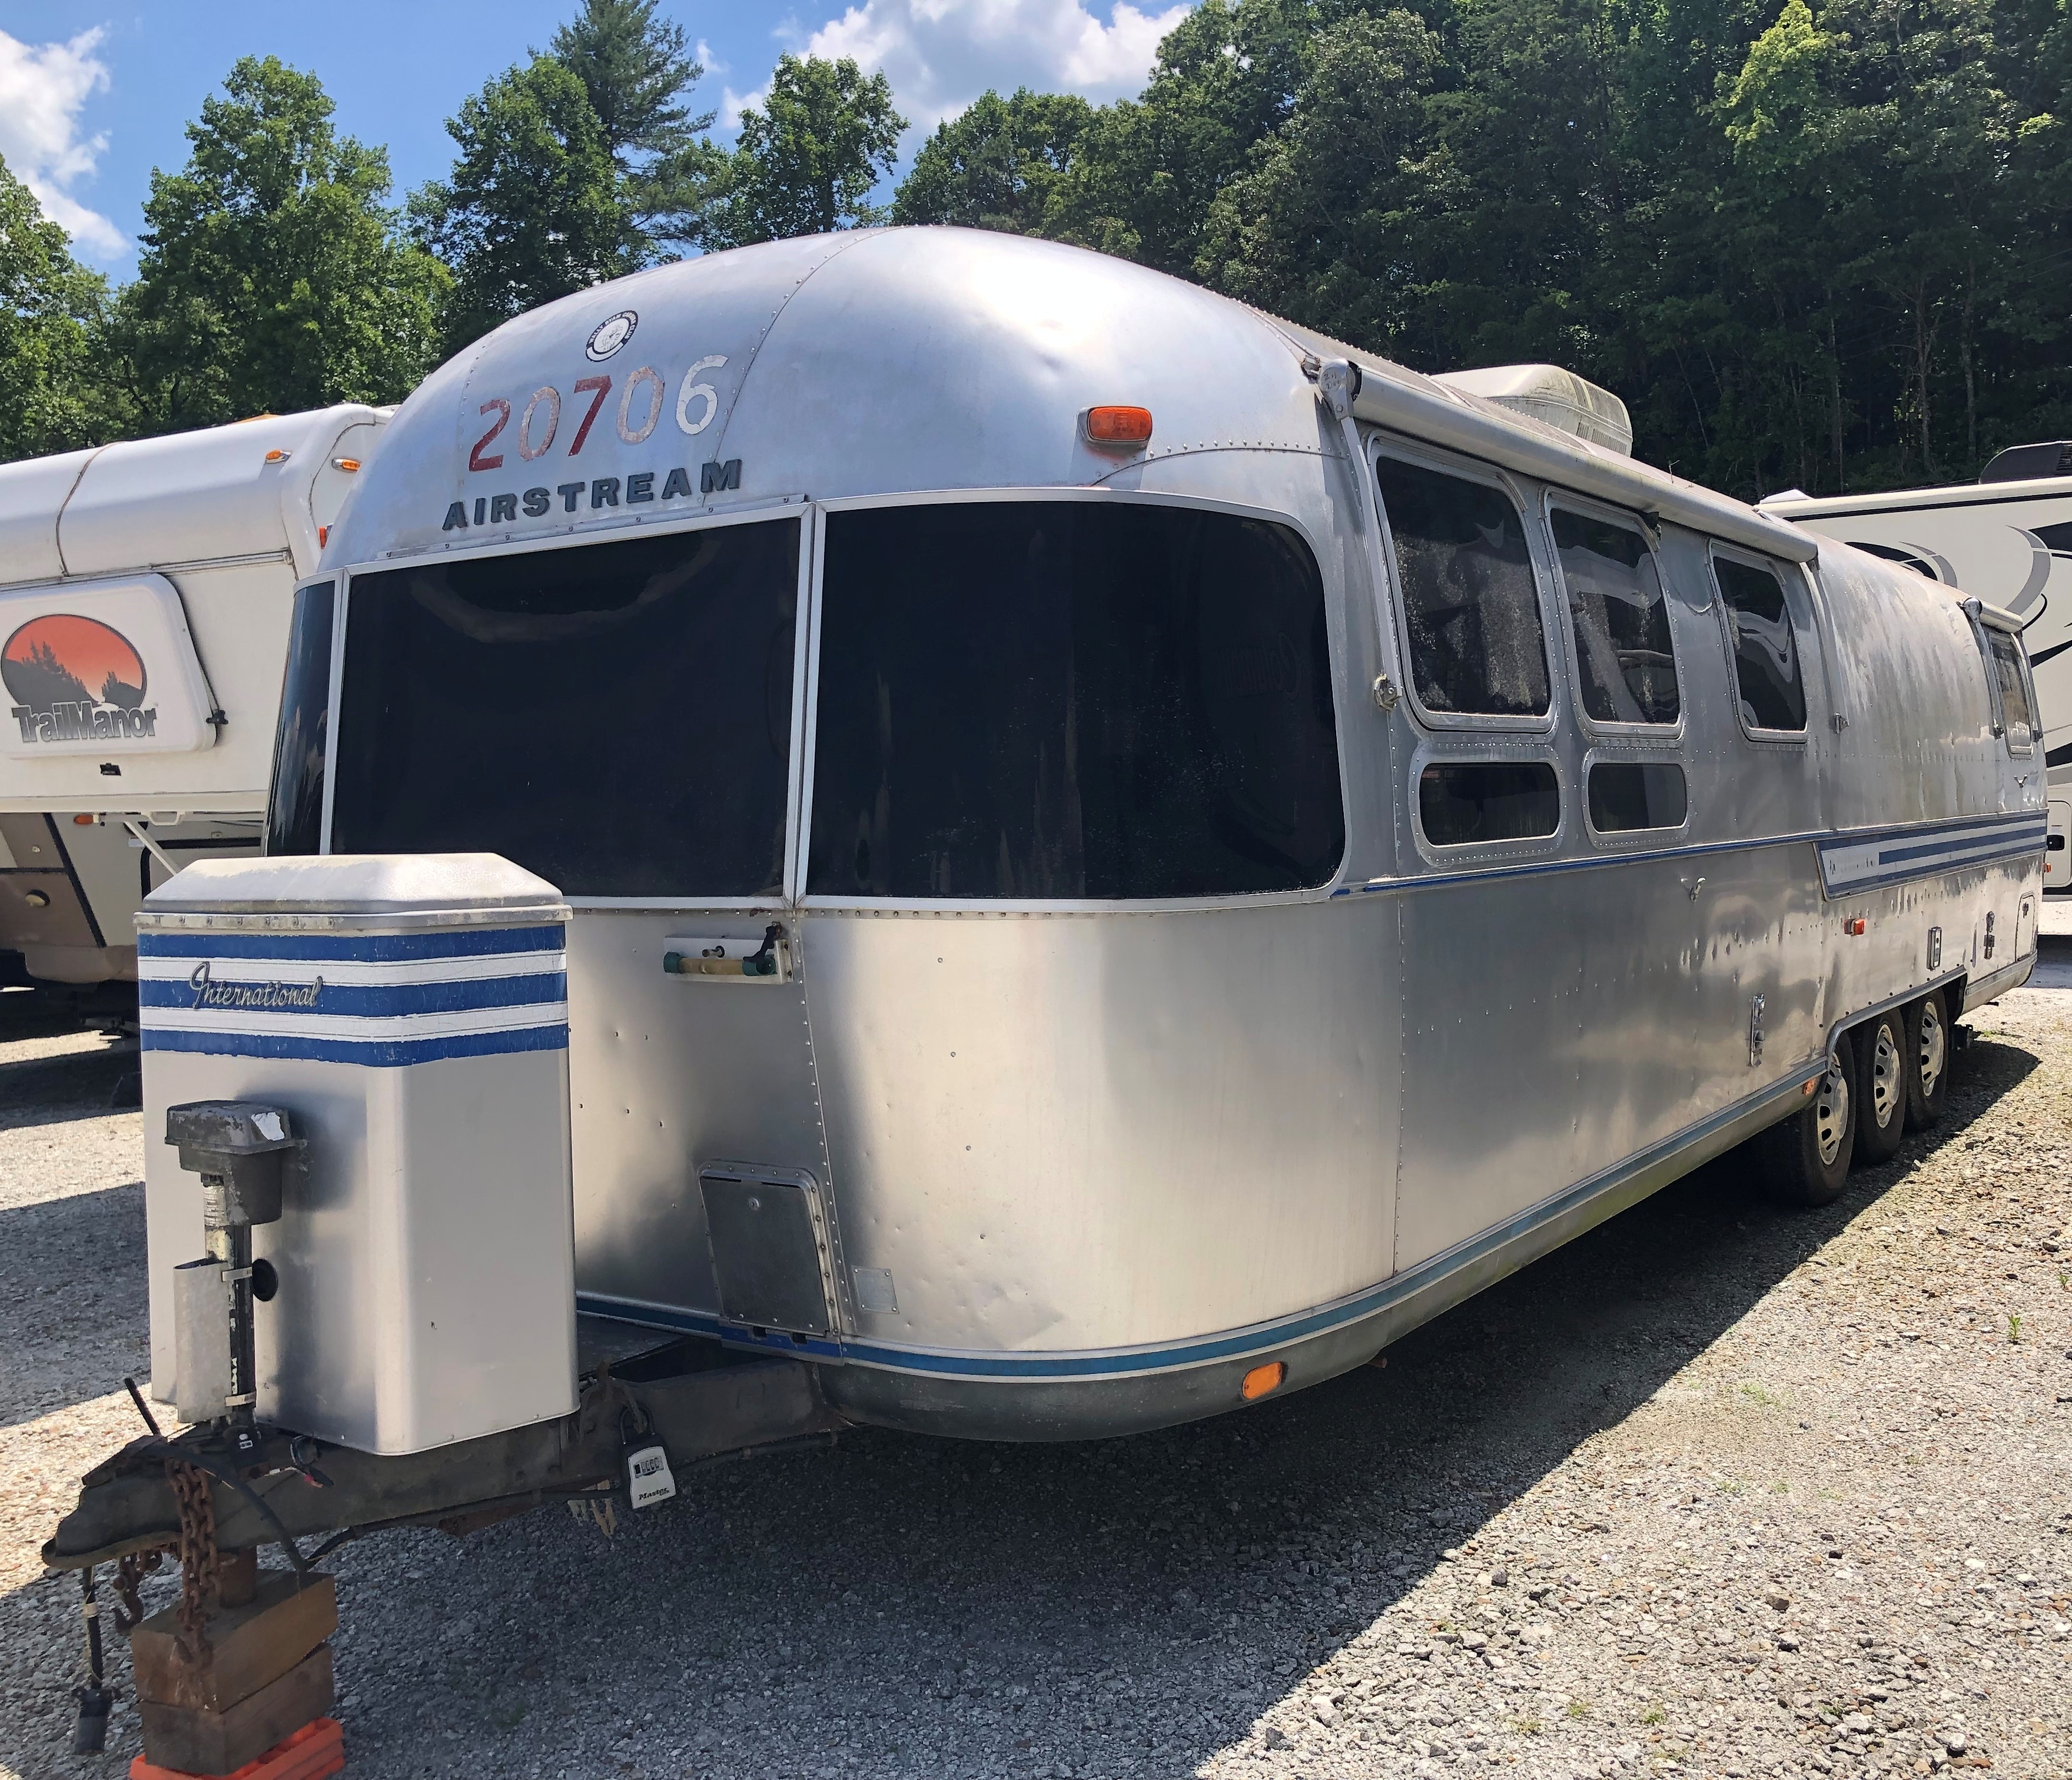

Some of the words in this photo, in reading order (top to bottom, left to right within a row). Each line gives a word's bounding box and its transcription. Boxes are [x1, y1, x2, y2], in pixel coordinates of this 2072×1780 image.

[588, 324, 603, 344] WALLY
[624, 324, 636, 339] CLUB
[469, 354, 729, 471] 20706
[442, 459, 742, 530] AIRSTREAM
[11, 700, 157, 743] TrailManor
[189, 961, 323, 1009] International
